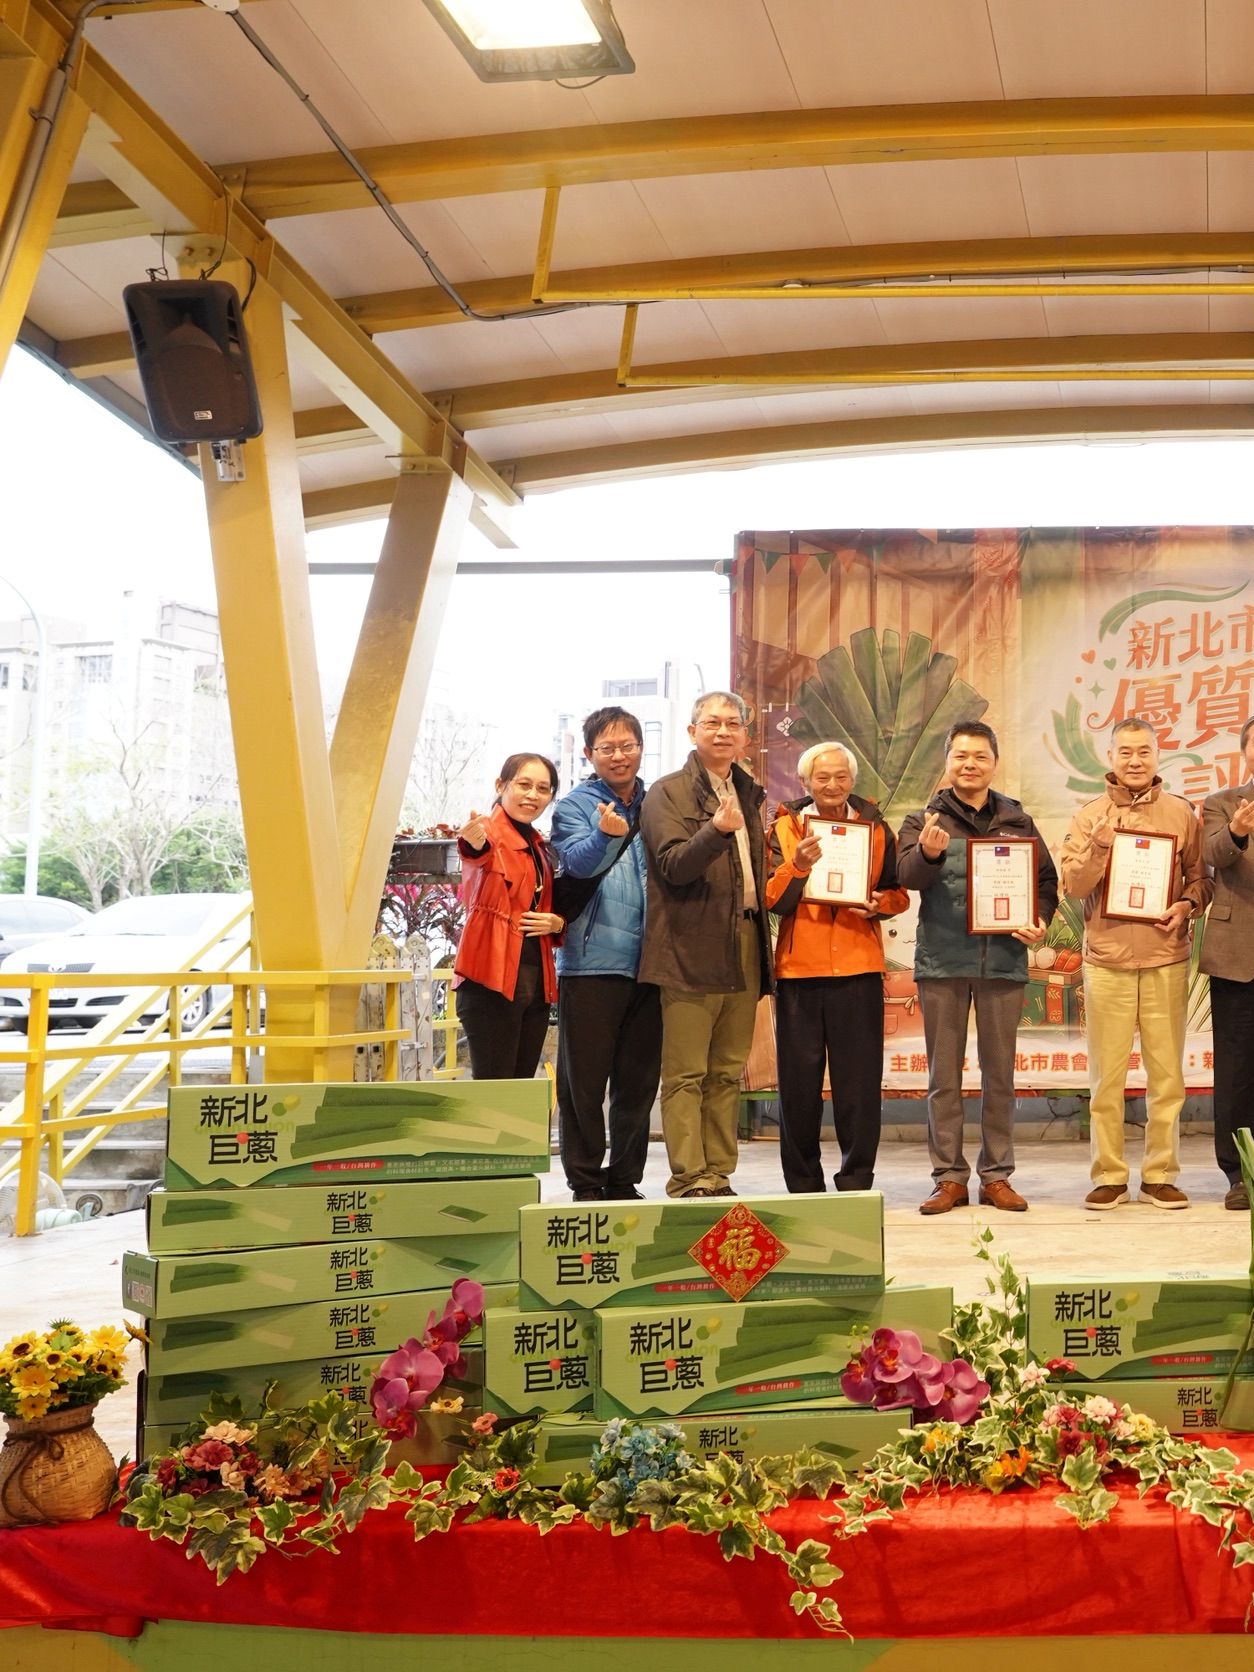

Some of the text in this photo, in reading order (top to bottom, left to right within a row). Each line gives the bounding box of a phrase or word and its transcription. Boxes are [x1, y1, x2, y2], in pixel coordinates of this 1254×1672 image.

[200, 1092, 268, 1128] 新北
[208, 1130, 278, 1165] 巨蔥
[326, 1190, 368, 1212] 新北
[332, 1213, 373, 1234] 巨蔥
[547, 1213, 610, 1248] 新北
[330, 1246, 369, 1270] 新北
[717, 1225, 762, 1272] 福
[335, 1270, 374, 1292] 巨蔥
[556, 1251, 620, 1286] 巨蔥
[329, 1304, 370, 1327] 新北
[1055, 1289, 1112, 1322] 新北
[335, 1327, 376, 1350] 巨蔥
[514, 1317, 579, 1355] 新北
[630, 1317, 693, 1355] 新北
[1063, 1325, 1122, 1357] 巨蔥
[321, 1363, 361, 1385] 新北
[523, 1355, 590, 1393] 巨蔥
[640, 1355, 704, 1394] 巨蔥
[1177, 1387, 1213, 1406] 新北
[1182, 1409, 1218, 1428] 巨蔥
[699, 1426, 739, 1449] 新北
